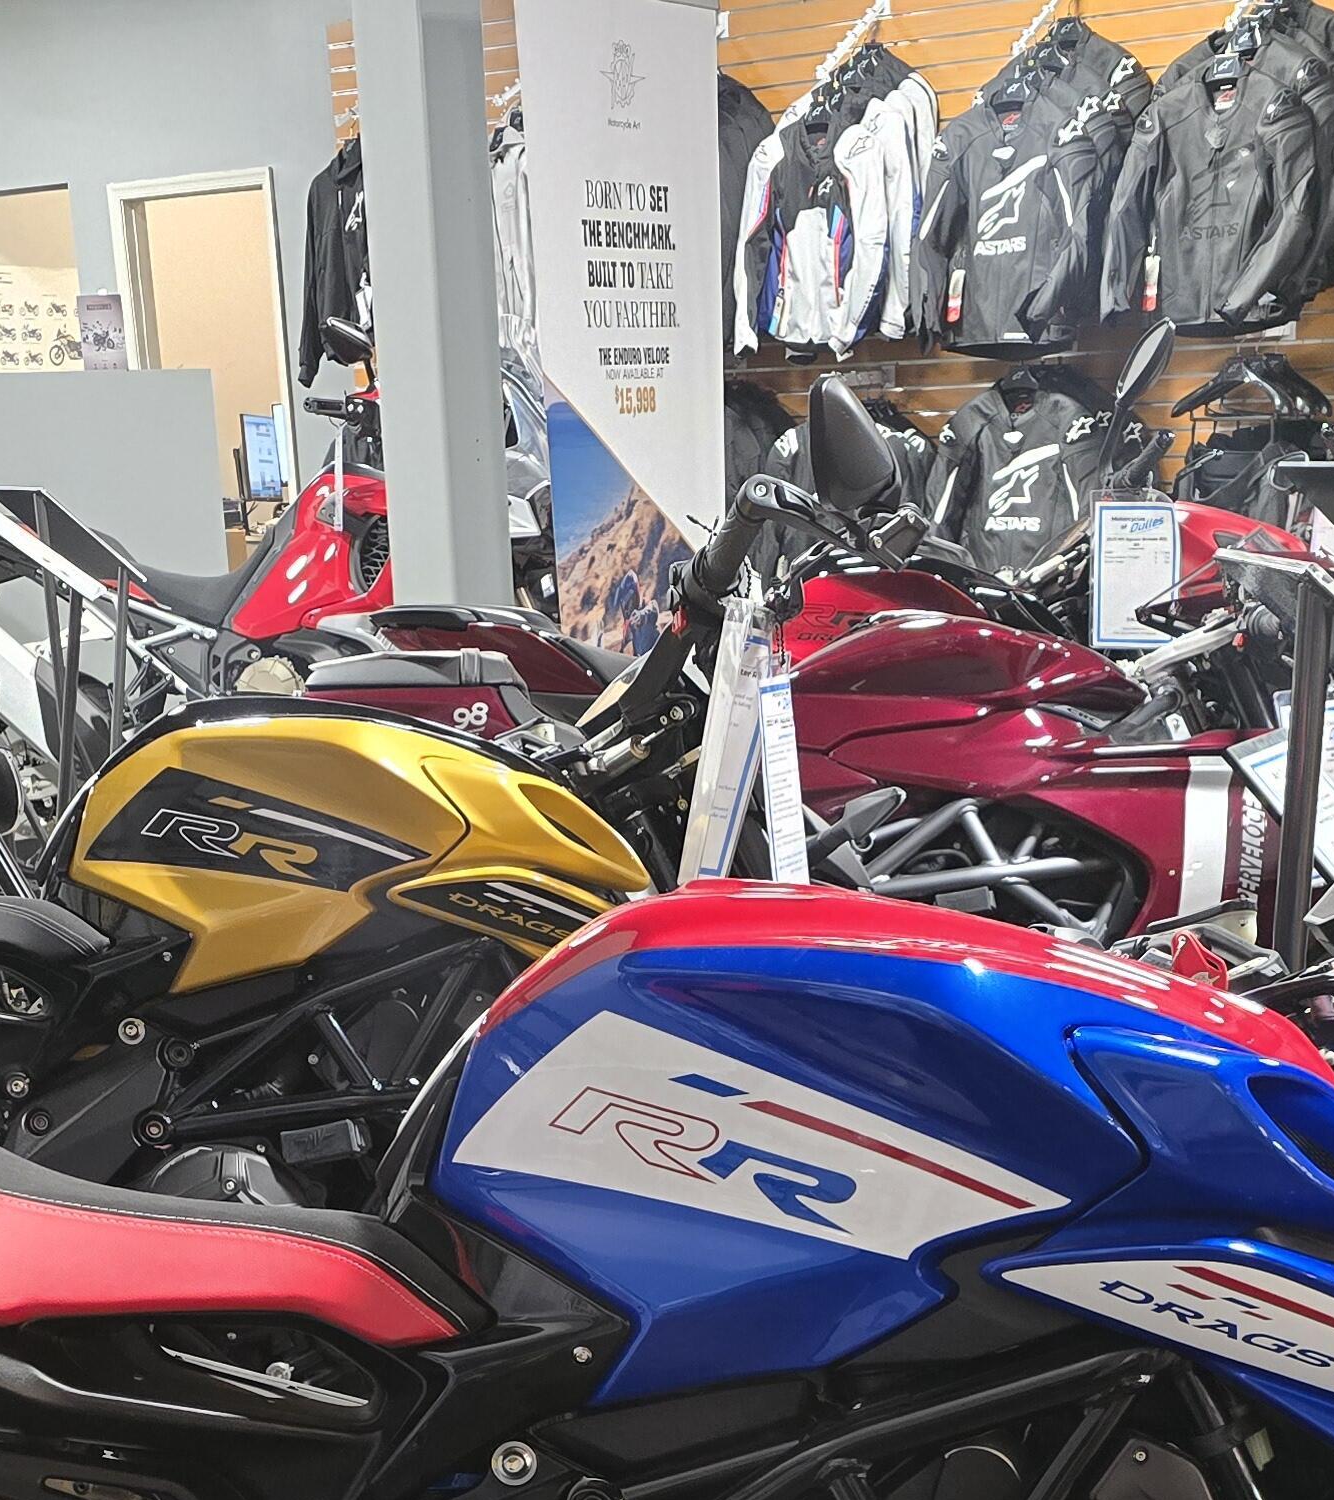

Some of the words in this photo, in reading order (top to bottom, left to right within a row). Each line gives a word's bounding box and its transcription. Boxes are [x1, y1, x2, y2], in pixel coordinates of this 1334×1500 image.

[585, 180, 622, 210] BORN
[626, 183, 646, 211] TO
[649, 185, 669, 213] SET
[581, 219, 603, 247] THE
[605, 221, 676, 250] BENCHMARK.
[1178, 222, 1240, 240] ASTARS
[973, 236, 1027, 257] ASTARS
[587, 260, 617, 288] BUILT
[620, 261, 635, 288] TO
[637, 262, 674, 289] TAKE
[583, 300, 613, 328] YOU
[617, 301, 680, 329] FARTHER.
[599, 348, 612, 366] THE
[613, 348, 642, 366] ENDURO
[644, 347, 670, 364] VELOCE
[605, 368, 622, 380] NOW
[622, 368, 656, 379] AVAILABLE
[656, 367, 664, 379] AT
[614, 384, 657, 417] $15,998
[984, 516, 1042, 533] ASTARS
[1130, 516, 1164, 533] Dulles
[453, 701, 489, 729] 98
[141, 808, 319, 880] RR
[447, 892, 571, 942] DRAGS
[548, 1085, 860, 1236] RR
